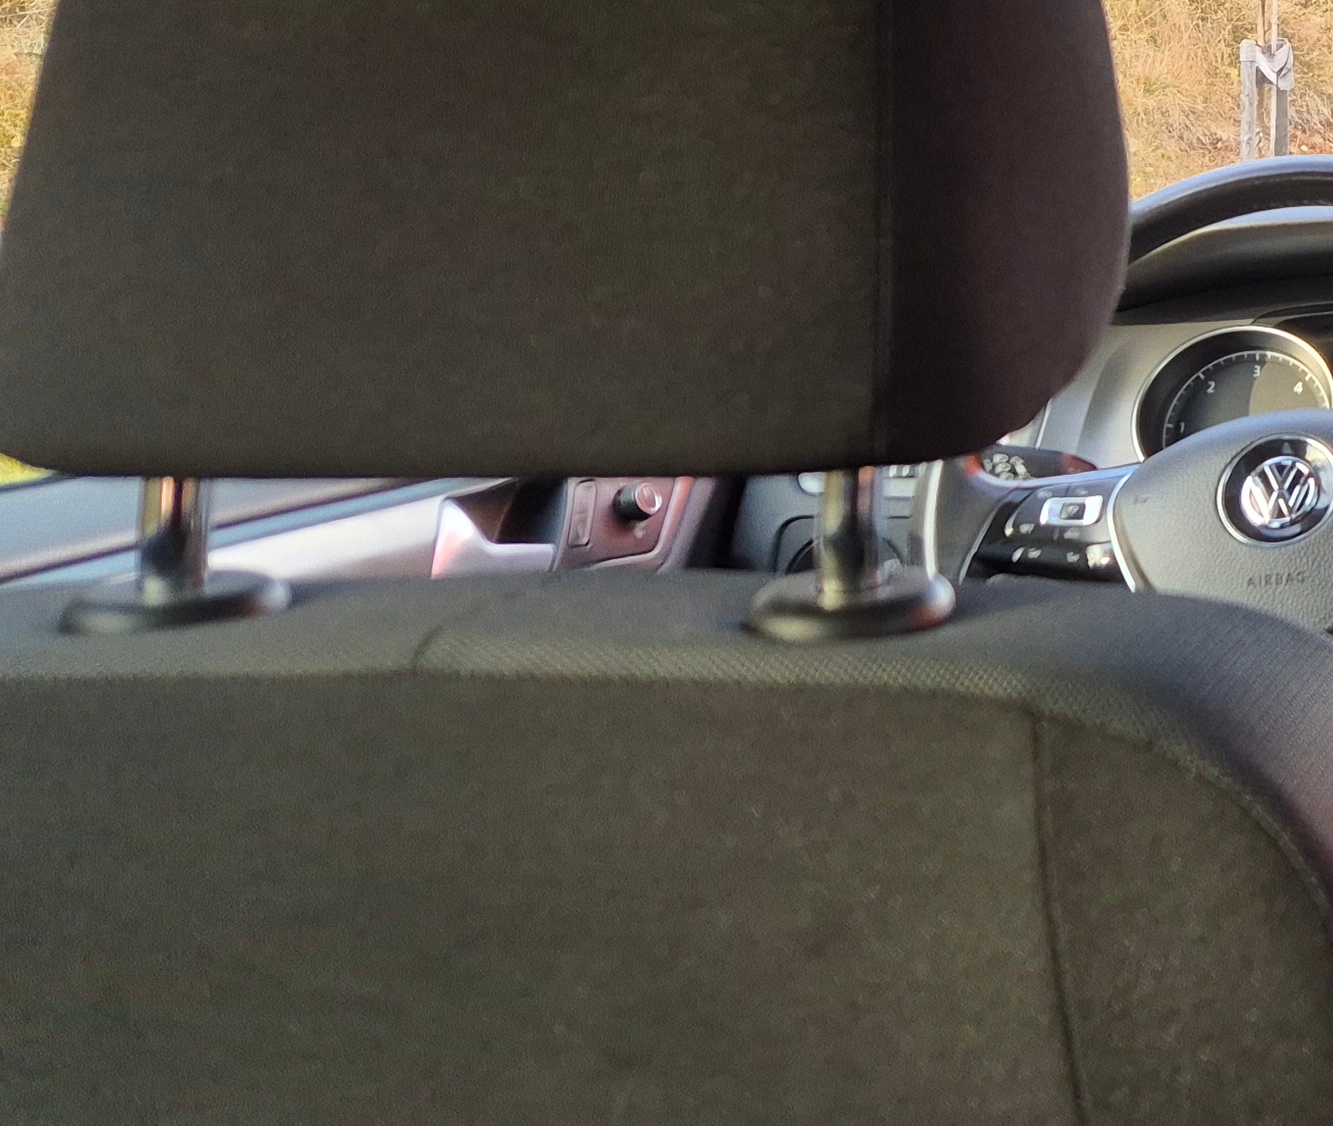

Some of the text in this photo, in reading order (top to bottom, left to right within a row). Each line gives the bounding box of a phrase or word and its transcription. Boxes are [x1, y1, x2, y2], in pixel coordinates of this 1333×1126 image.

[1206, 381, 1216, 393] 2
[1253, 365, 1261, 377] 3
[1293, 381, 1304, 394] 4
[1247, 571, 1306, 587] AIRBAG
